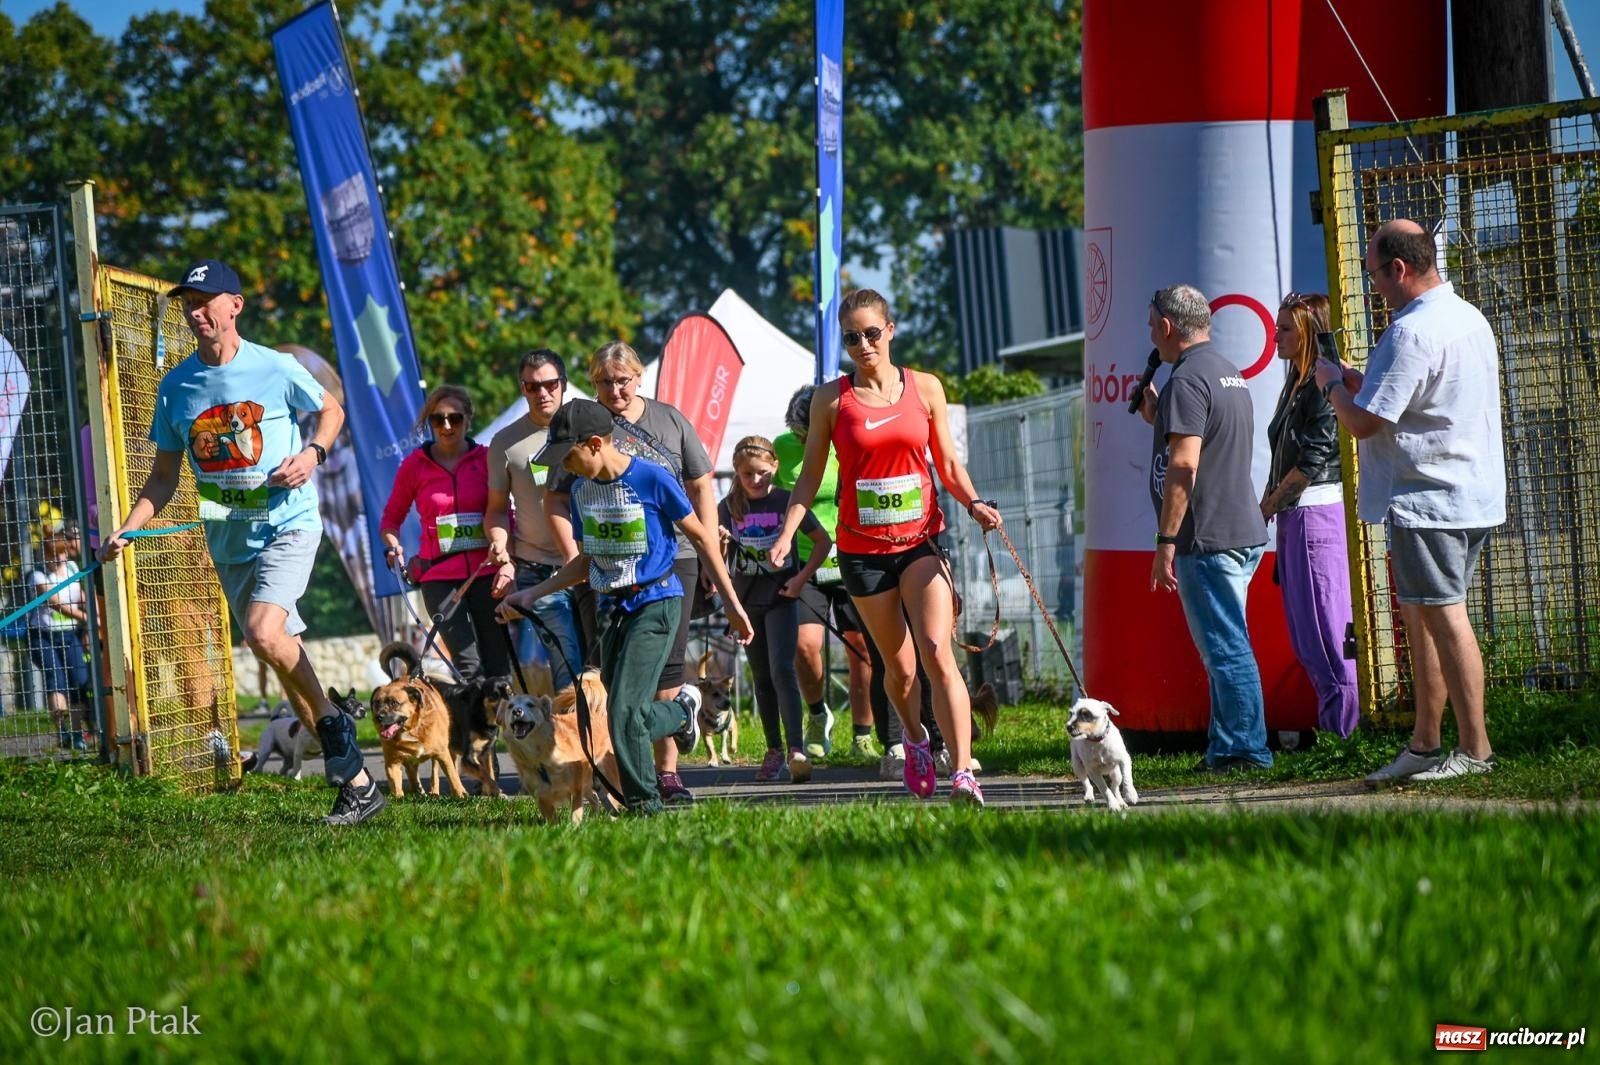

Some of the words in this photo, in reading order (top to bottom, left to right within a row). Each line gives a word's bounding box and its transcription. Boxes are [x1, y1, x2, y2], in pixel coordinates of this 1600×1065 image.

[706, 364, 730, 420] OSiR
[221, 489, 247, 504] 84
[878, 493, 903, 509] 98
[454, 525, 473, 538] 80
[598, 523, 623, 539] 95
